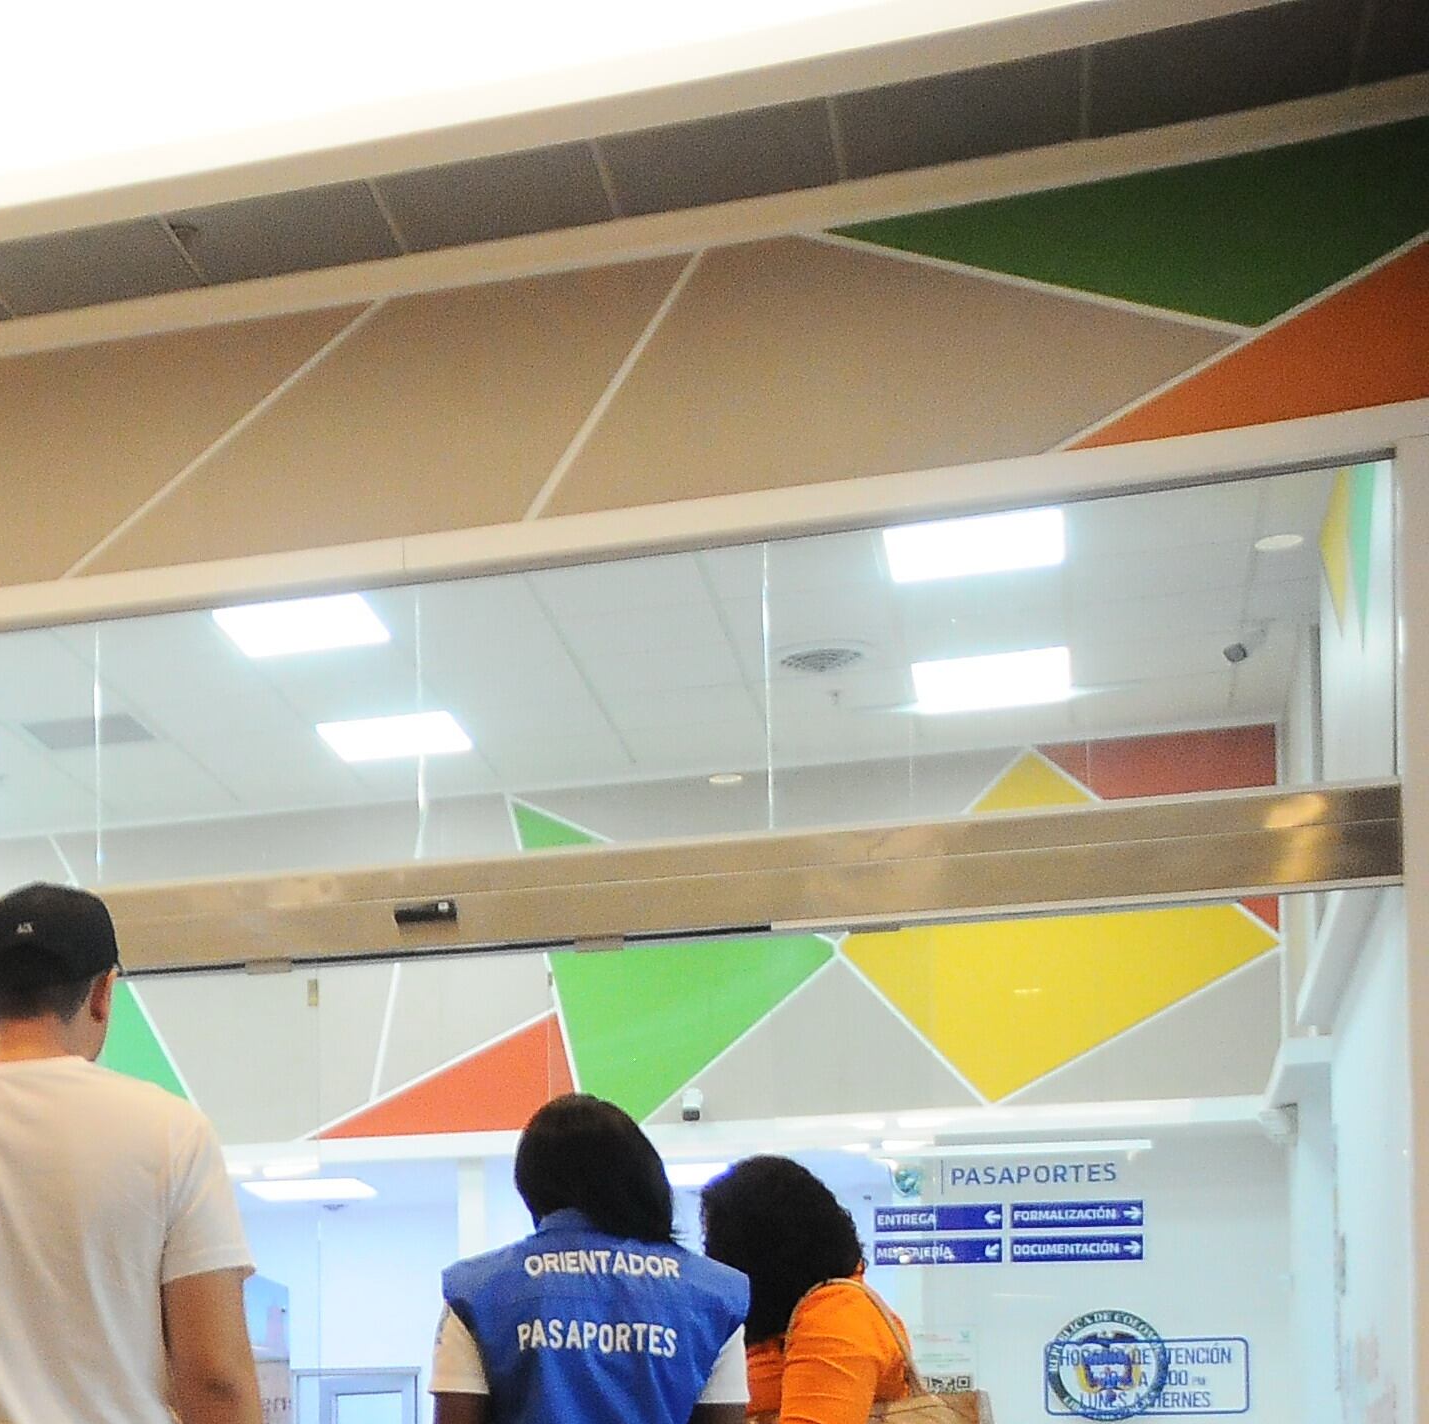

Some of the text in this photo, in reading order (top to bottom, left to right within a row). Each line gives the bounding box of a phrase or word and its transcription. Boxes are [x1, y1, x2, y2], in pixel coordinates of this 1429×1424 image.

[950, 1162, 1117, 1187] PASAPORTES
[876, 1213, 936, 1226] ENTREGA
[1013, 1206, 1117, 1221] FORMALIZACIÓN
[876, 1244, 954, 1260] MESAJERÍA
[1013, 1240, 1120, 1255] DOCUMENTACIÓN
[523, 1249, 681, 1278] ORIENTADOR
[516, 1319, 678, 1358] PASAPORTES
[1155, 1342, 1232, 1365] TENCIÓN
